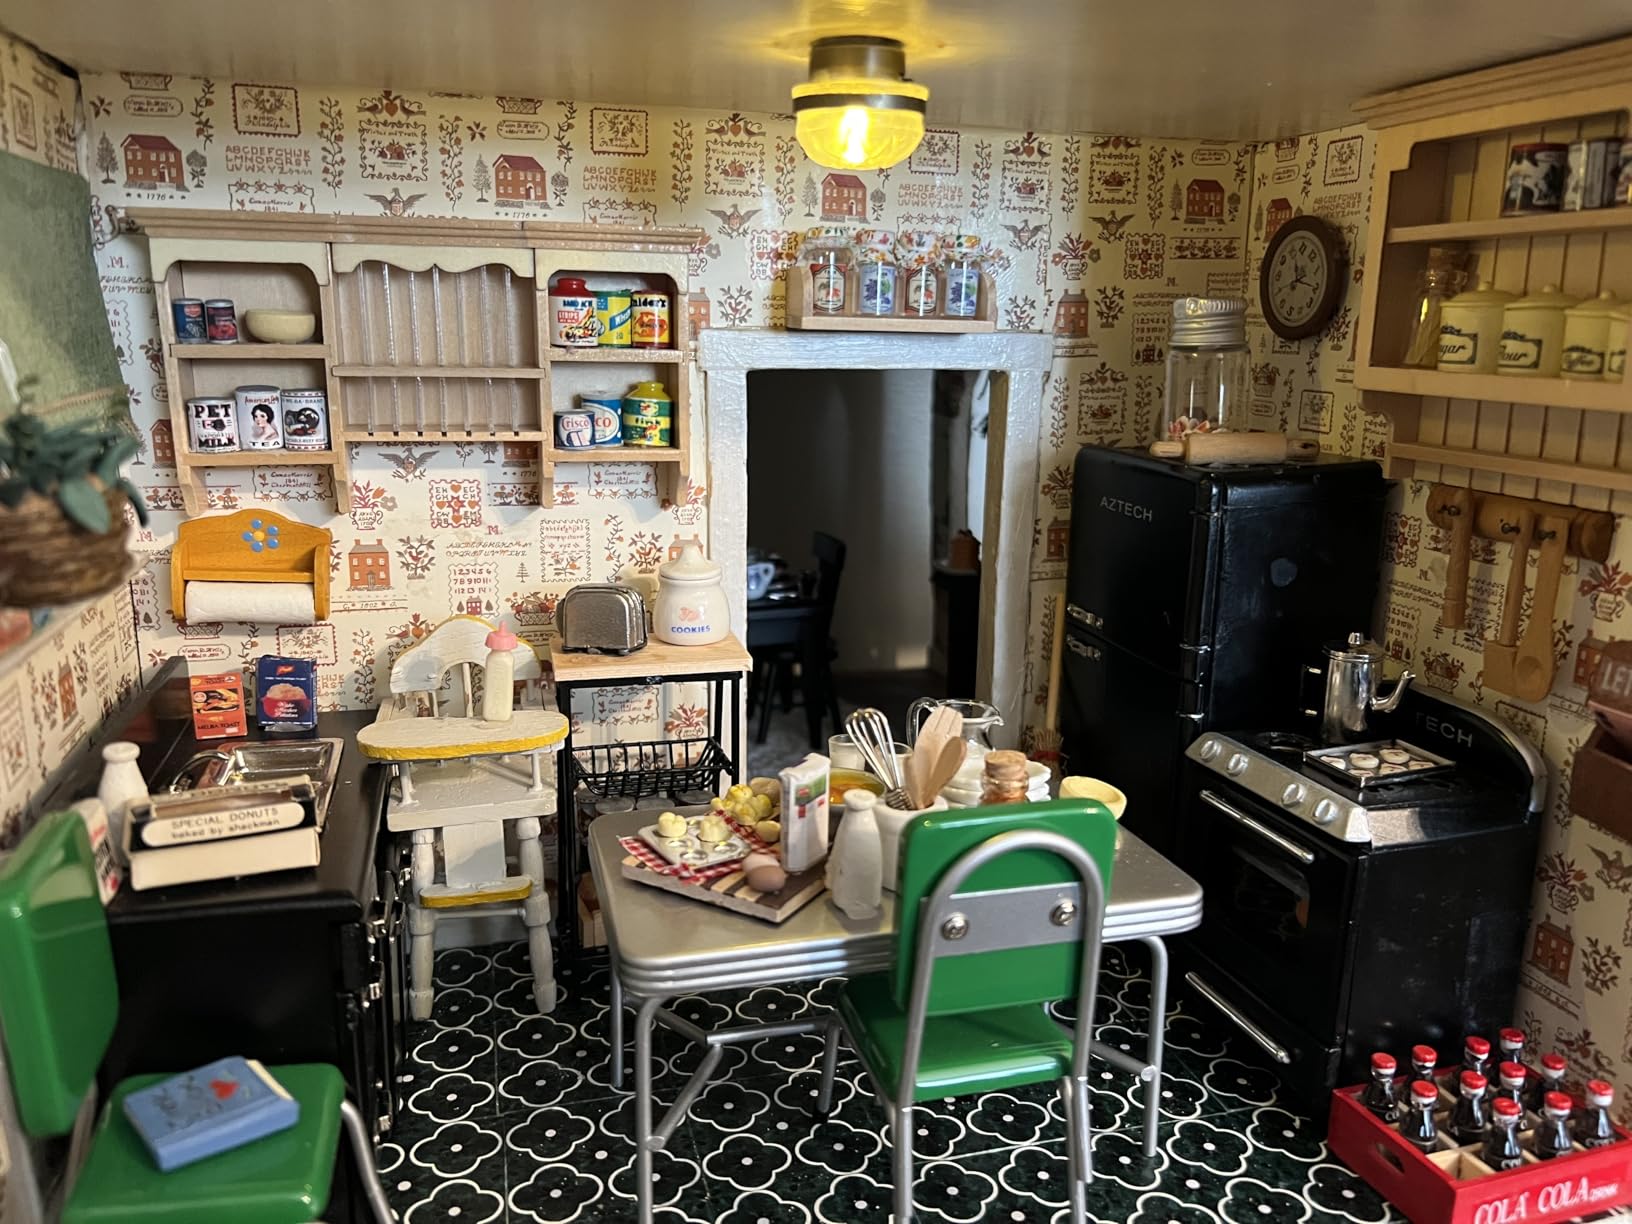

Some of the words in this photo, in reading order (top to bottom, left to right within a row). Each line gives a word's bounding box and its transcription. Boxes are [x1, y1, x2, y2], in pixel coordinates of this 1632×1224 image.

[146, 192, 166, 200] 1776
[194, 404, 231, 419] PET
[561, 416, 590, 431] Crisco
[199, 435, 236, 447] MILK
[1099, 496, 1153, 522] AZTECH
[671, 625, 712, 634] COOKIES
[1415, 711, 1474, 748] TECH
[171, 815, 224, 829] SPECIAL
[228, 807, 280, 822] DONUTS
[171, 829, 206, 839] baked
[210, 826, 223, 838] by
[227, 818, 281, 833] shackman
[1473, 1191, 1530, 1224] COLA
[1537, 1176, 1589, 1215] COLA
